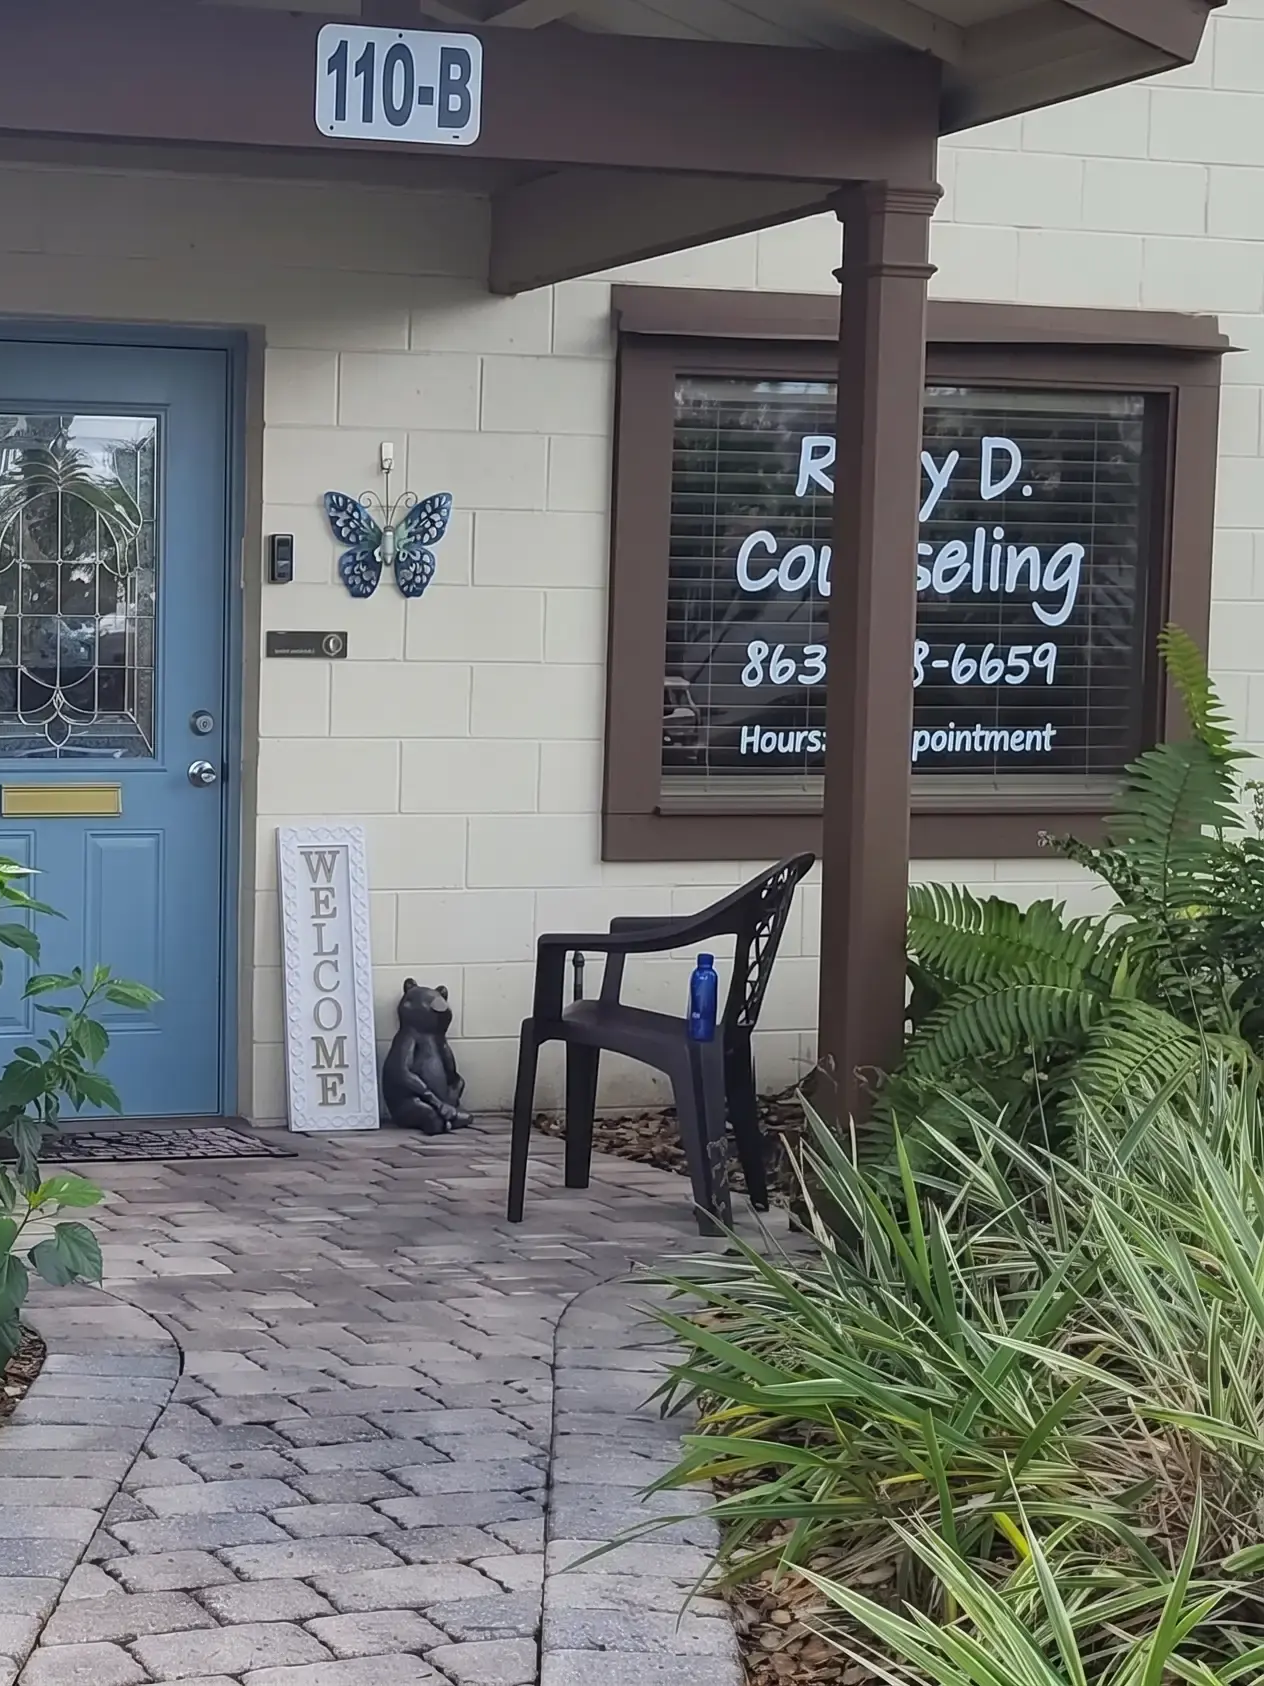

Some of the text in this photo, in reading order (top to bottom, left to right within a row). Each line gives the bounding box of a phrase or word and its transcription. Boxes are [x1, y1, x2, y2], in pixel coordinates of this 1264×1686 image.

[327, 40, 472, 128] 110-B
[794, 436, 1033, 522] Ry D.
[299, 850, 349, 1107] WELCOME
